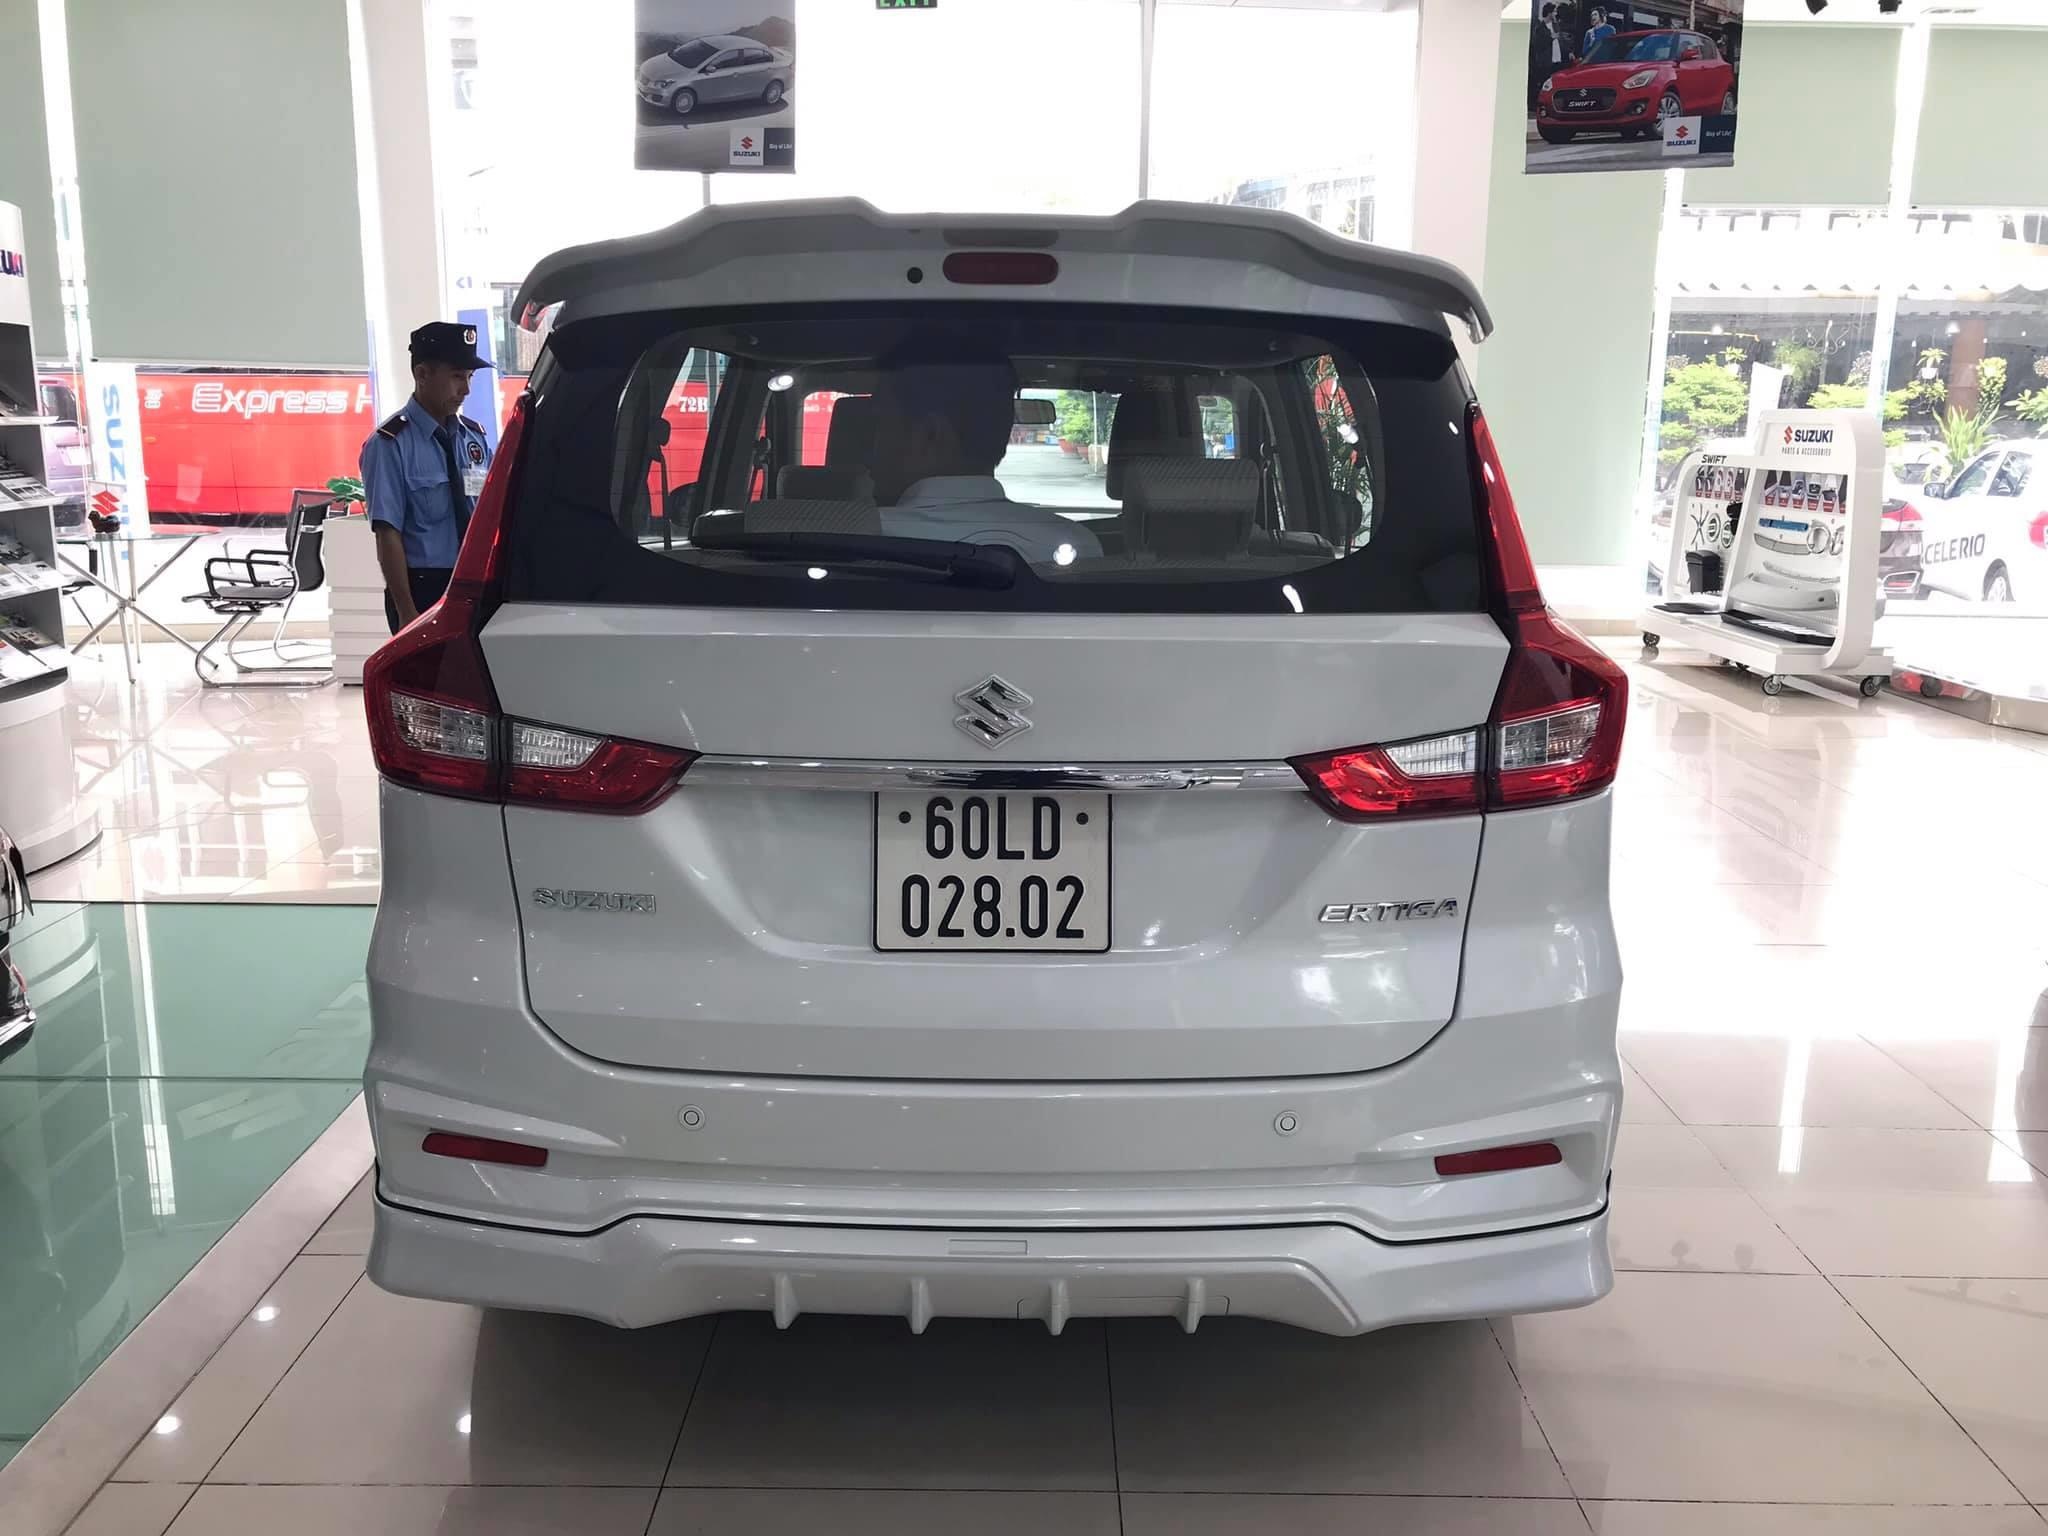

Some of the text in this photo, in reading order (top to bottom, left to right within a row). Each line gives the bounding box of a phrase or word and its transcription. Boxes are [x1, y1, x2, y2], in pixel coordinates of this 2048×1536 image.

[191, 383, 348, 419] Express
[1794, 429, 1834, 443] SUZUKI
[1701, 454, 1727, 465] SWIFT
[1925, 533, 1986, 565] CELERIO
[926, 796, 1061, 860] 60LD
[533, 888, 657, 913] SUZUKI
[902, 874, 1085, 938] 028.02
[1318, 898, 1458, 923] ERTIGA
